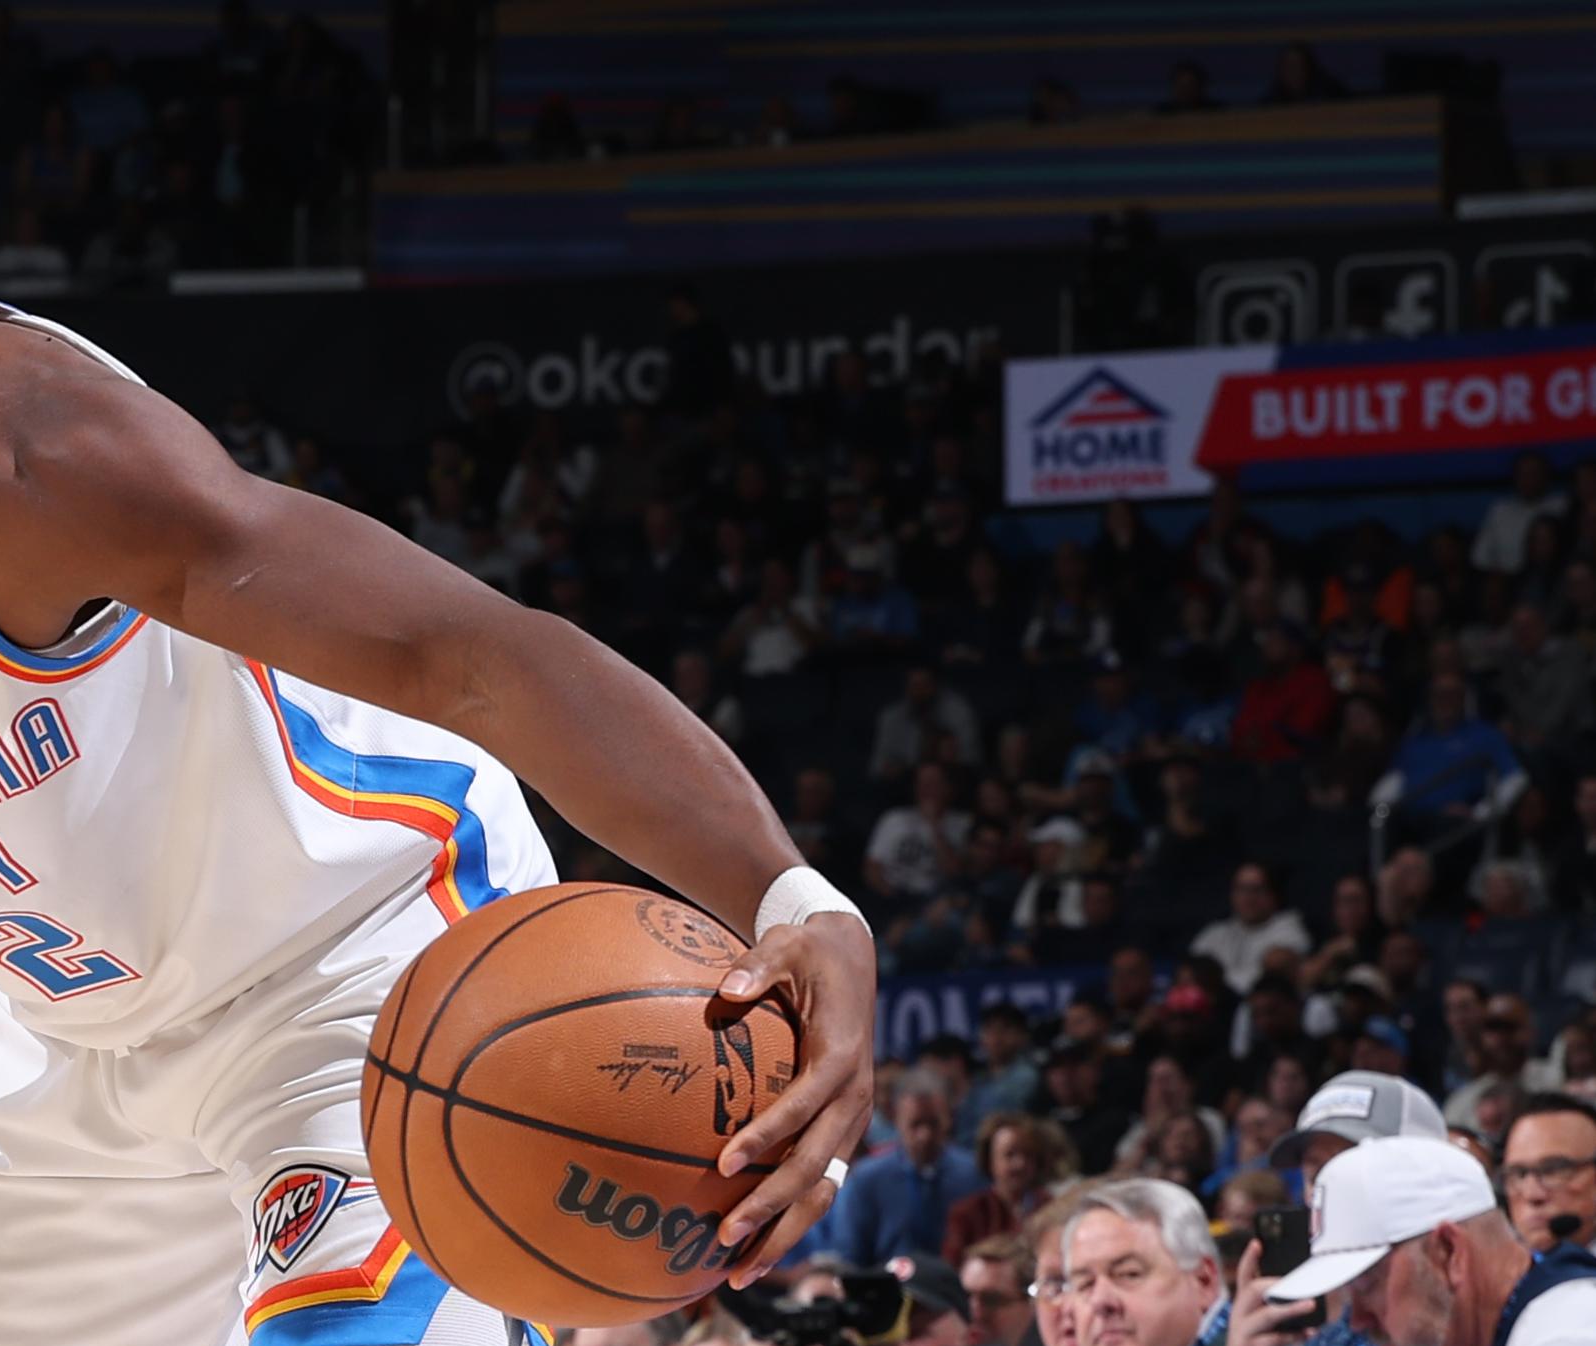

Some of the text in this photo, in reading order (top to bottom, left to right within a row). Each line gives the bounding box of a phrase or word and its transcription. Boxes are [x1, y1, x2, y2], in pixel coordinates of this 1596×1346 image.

[445, 311, 1001, 423] @okcundr
[1250, 367, 1596, 440] BUILT FOR G
[1032, 427, 1167, 469] HOME
[254, 1179, 322, 1270] OKC
[554, 1160, 749, 1278] lson
